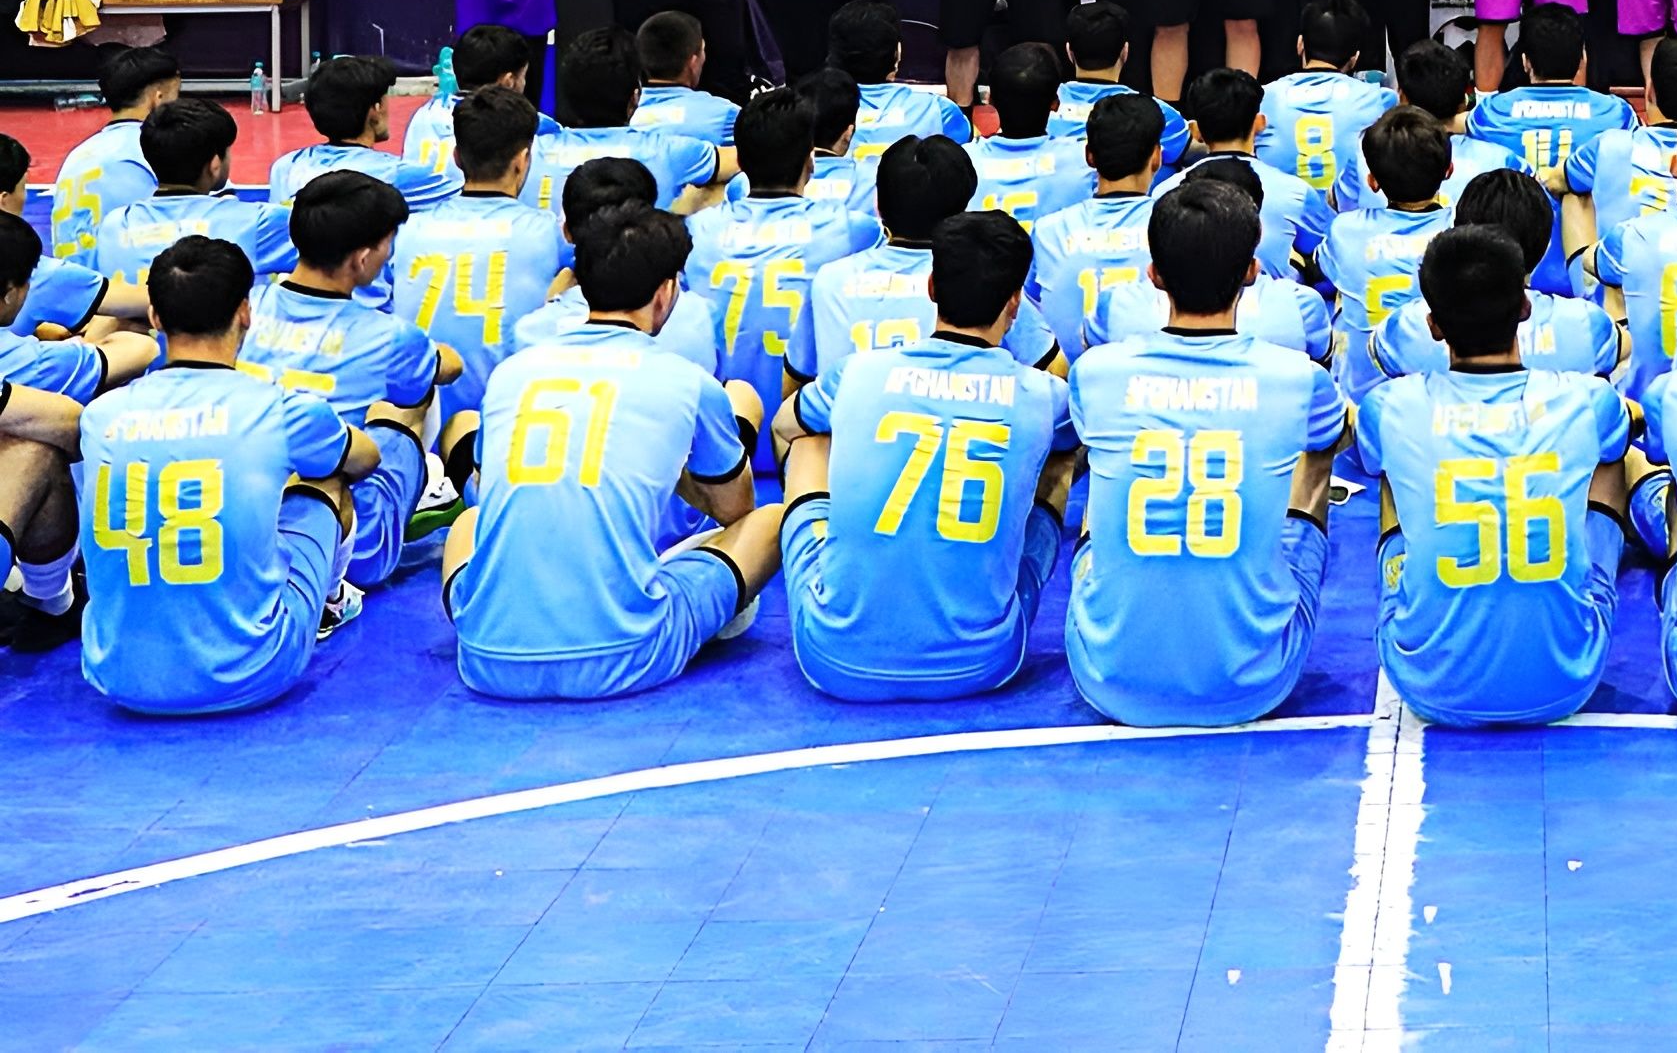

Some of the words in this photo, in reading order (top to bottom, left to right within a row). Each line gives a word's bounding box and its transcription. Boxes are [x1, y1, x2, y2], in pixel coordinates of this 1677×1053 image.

[1294, 114, 1337, 189] 8
[408, 249, 508, 345] 74
[710, 258, 805, 358] 75
[506, 377, 619, 487] 61
[884, 366, 1015, 407] AFGHANISTAN
[93, 457, 225, 587] 48
[874, 410, 1011, 544] 76
[1126, 428, 1245, 558] 28
[1433, 451, 1567, 589] 56
